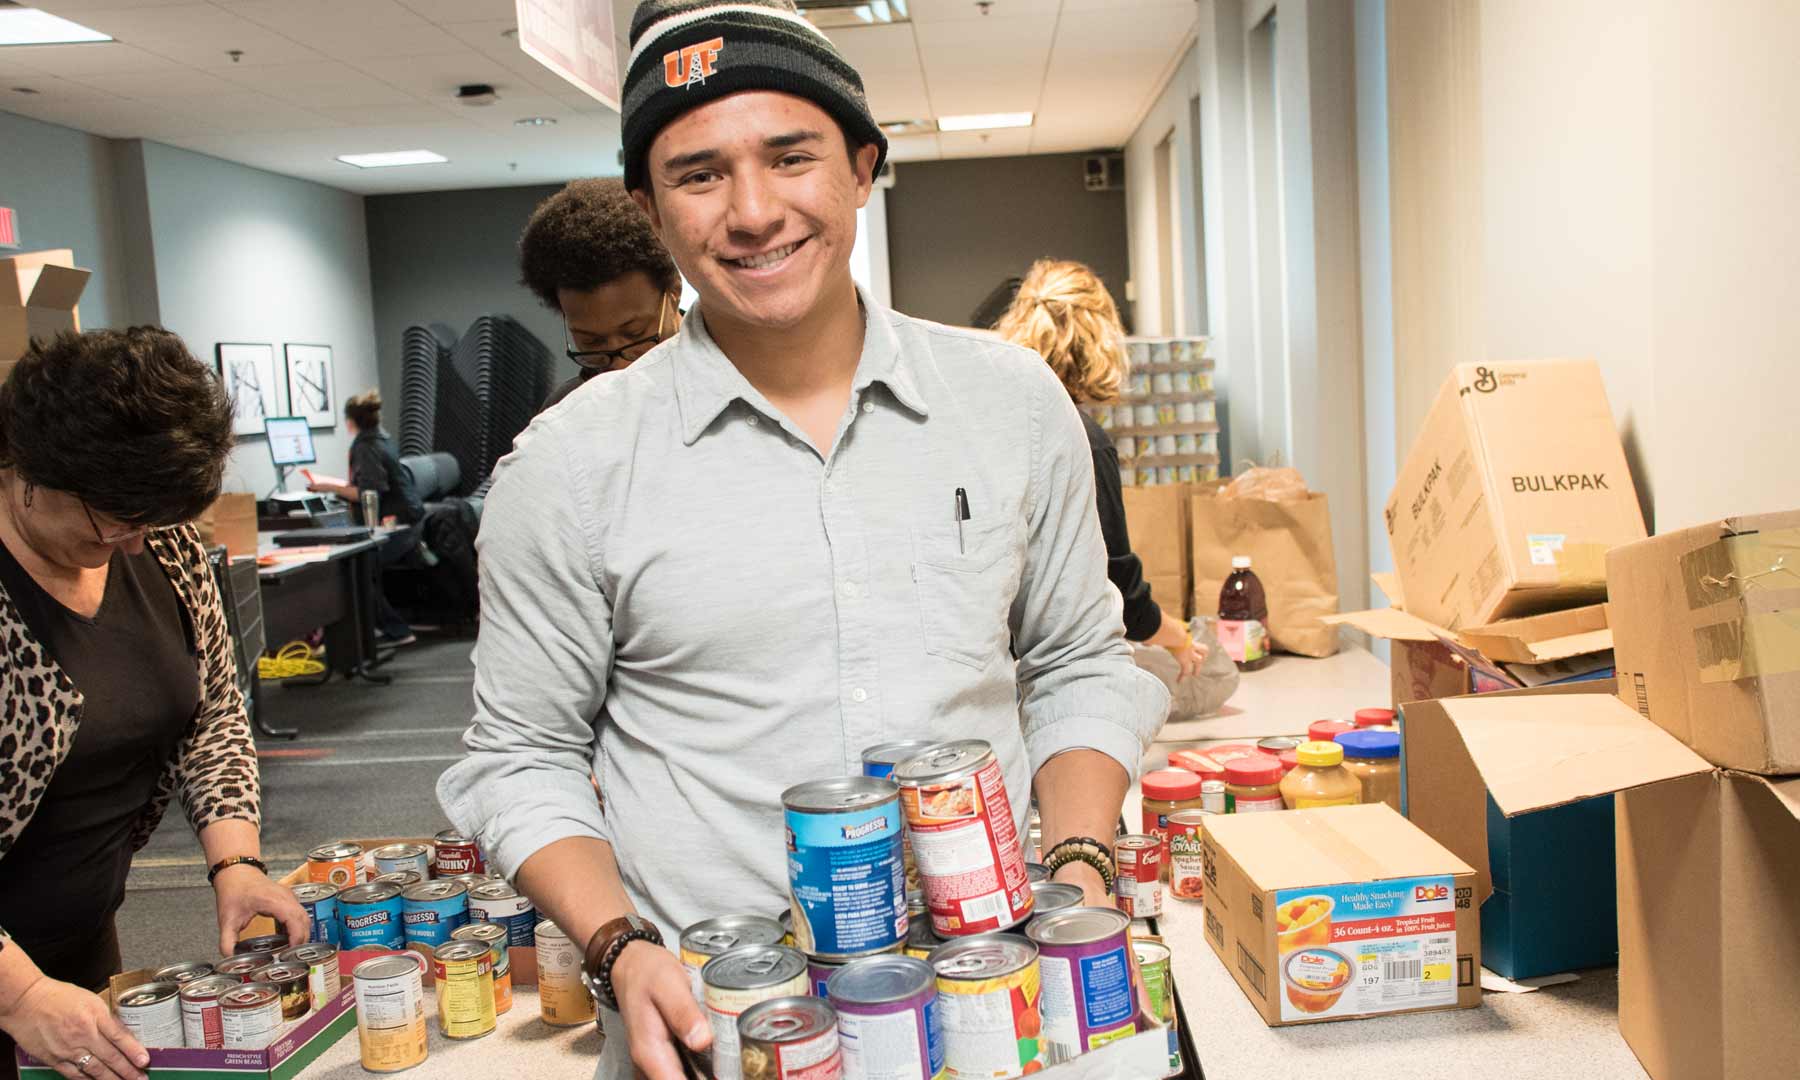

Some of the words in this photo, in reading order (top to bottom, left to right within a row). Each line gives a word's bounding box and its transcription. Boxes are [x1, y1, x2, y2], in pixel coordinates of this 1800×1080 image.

[1411, 457, 1442, 521] BULKPAK
[1511, 473, 1609, 493] BULKPAK
[846, 817, 886, 839] PROGRESSO
[437, 859, 470, 871] CHUNKY
[1341, 892, 1369, 904] Healthy
[1370, 889, 1406, 900] Snacking
[1415, 884, 1449, 902] Dole
[1352, 901, 1374, 911] Made
[1375, 898, 1394, 911] Easy!
[347, 912, 388, 929] PROGRESSO
[1396, 918, 1420, 928] Tropical
[1420, 916, 1435, 925] Fruit
[1334, 926, 1346, 938] 36
[1347, 922, 1379, 936] Count-4
[1380, 925, 1394, 933] oz.
[1363, 976, 1379, 985] 197
[1424, 971, 1431, 979] 2
